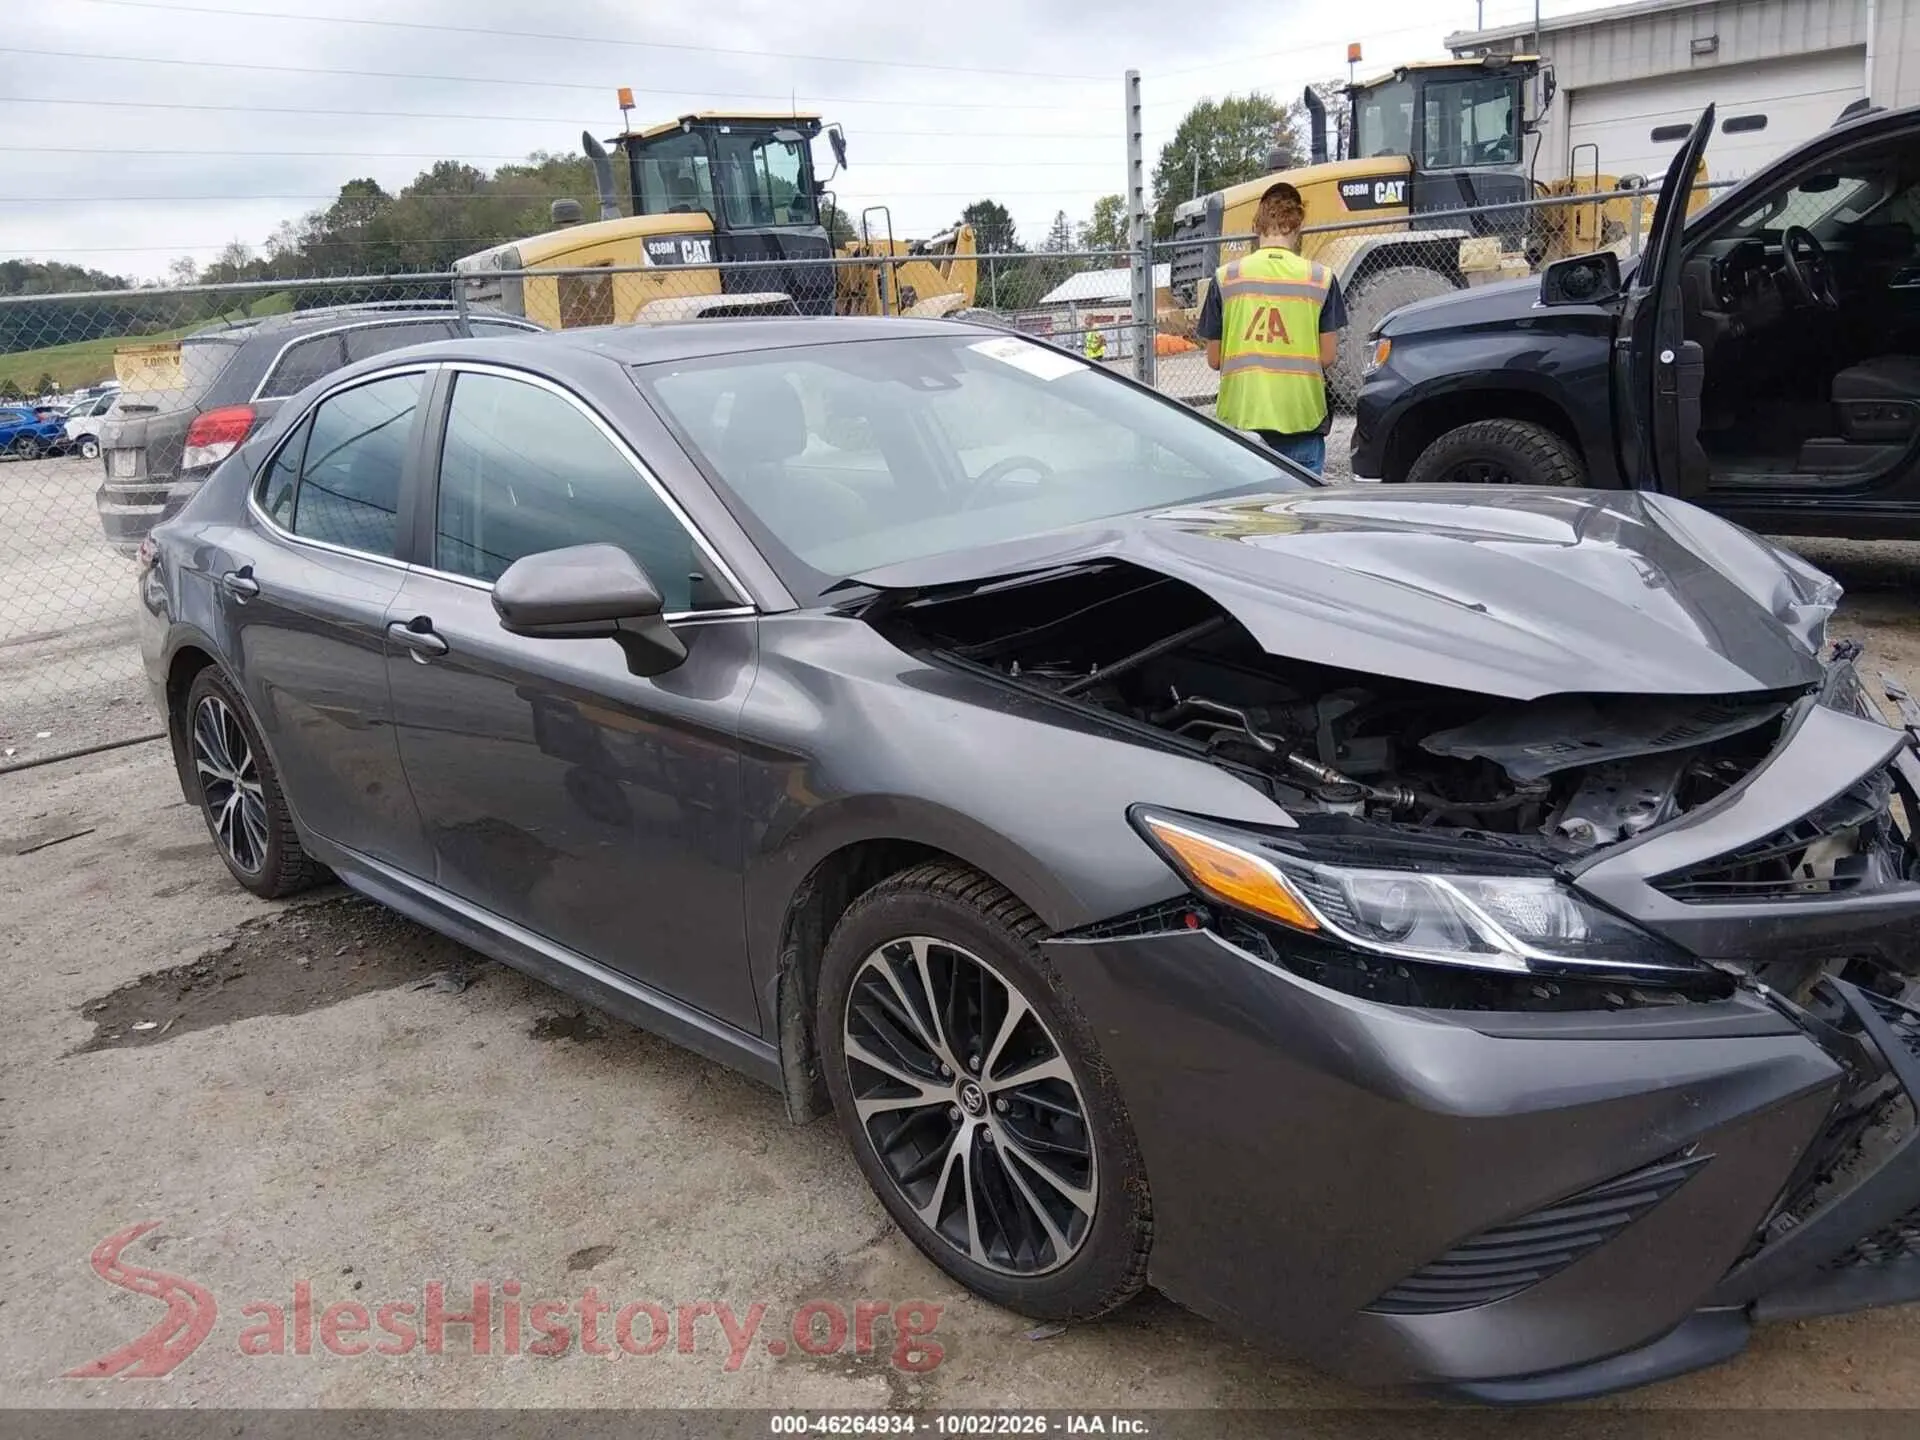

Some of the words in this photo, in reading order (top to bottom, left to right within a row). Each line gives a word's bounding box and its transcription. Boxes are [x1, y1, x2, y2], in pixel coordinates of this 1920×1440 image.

[1343, 184, 1369, 196] 938M
[1375, 182, 1405, 204] CAT
[648, 243, 676, 255] 938M
[682, 240, 712, 263] CAT
